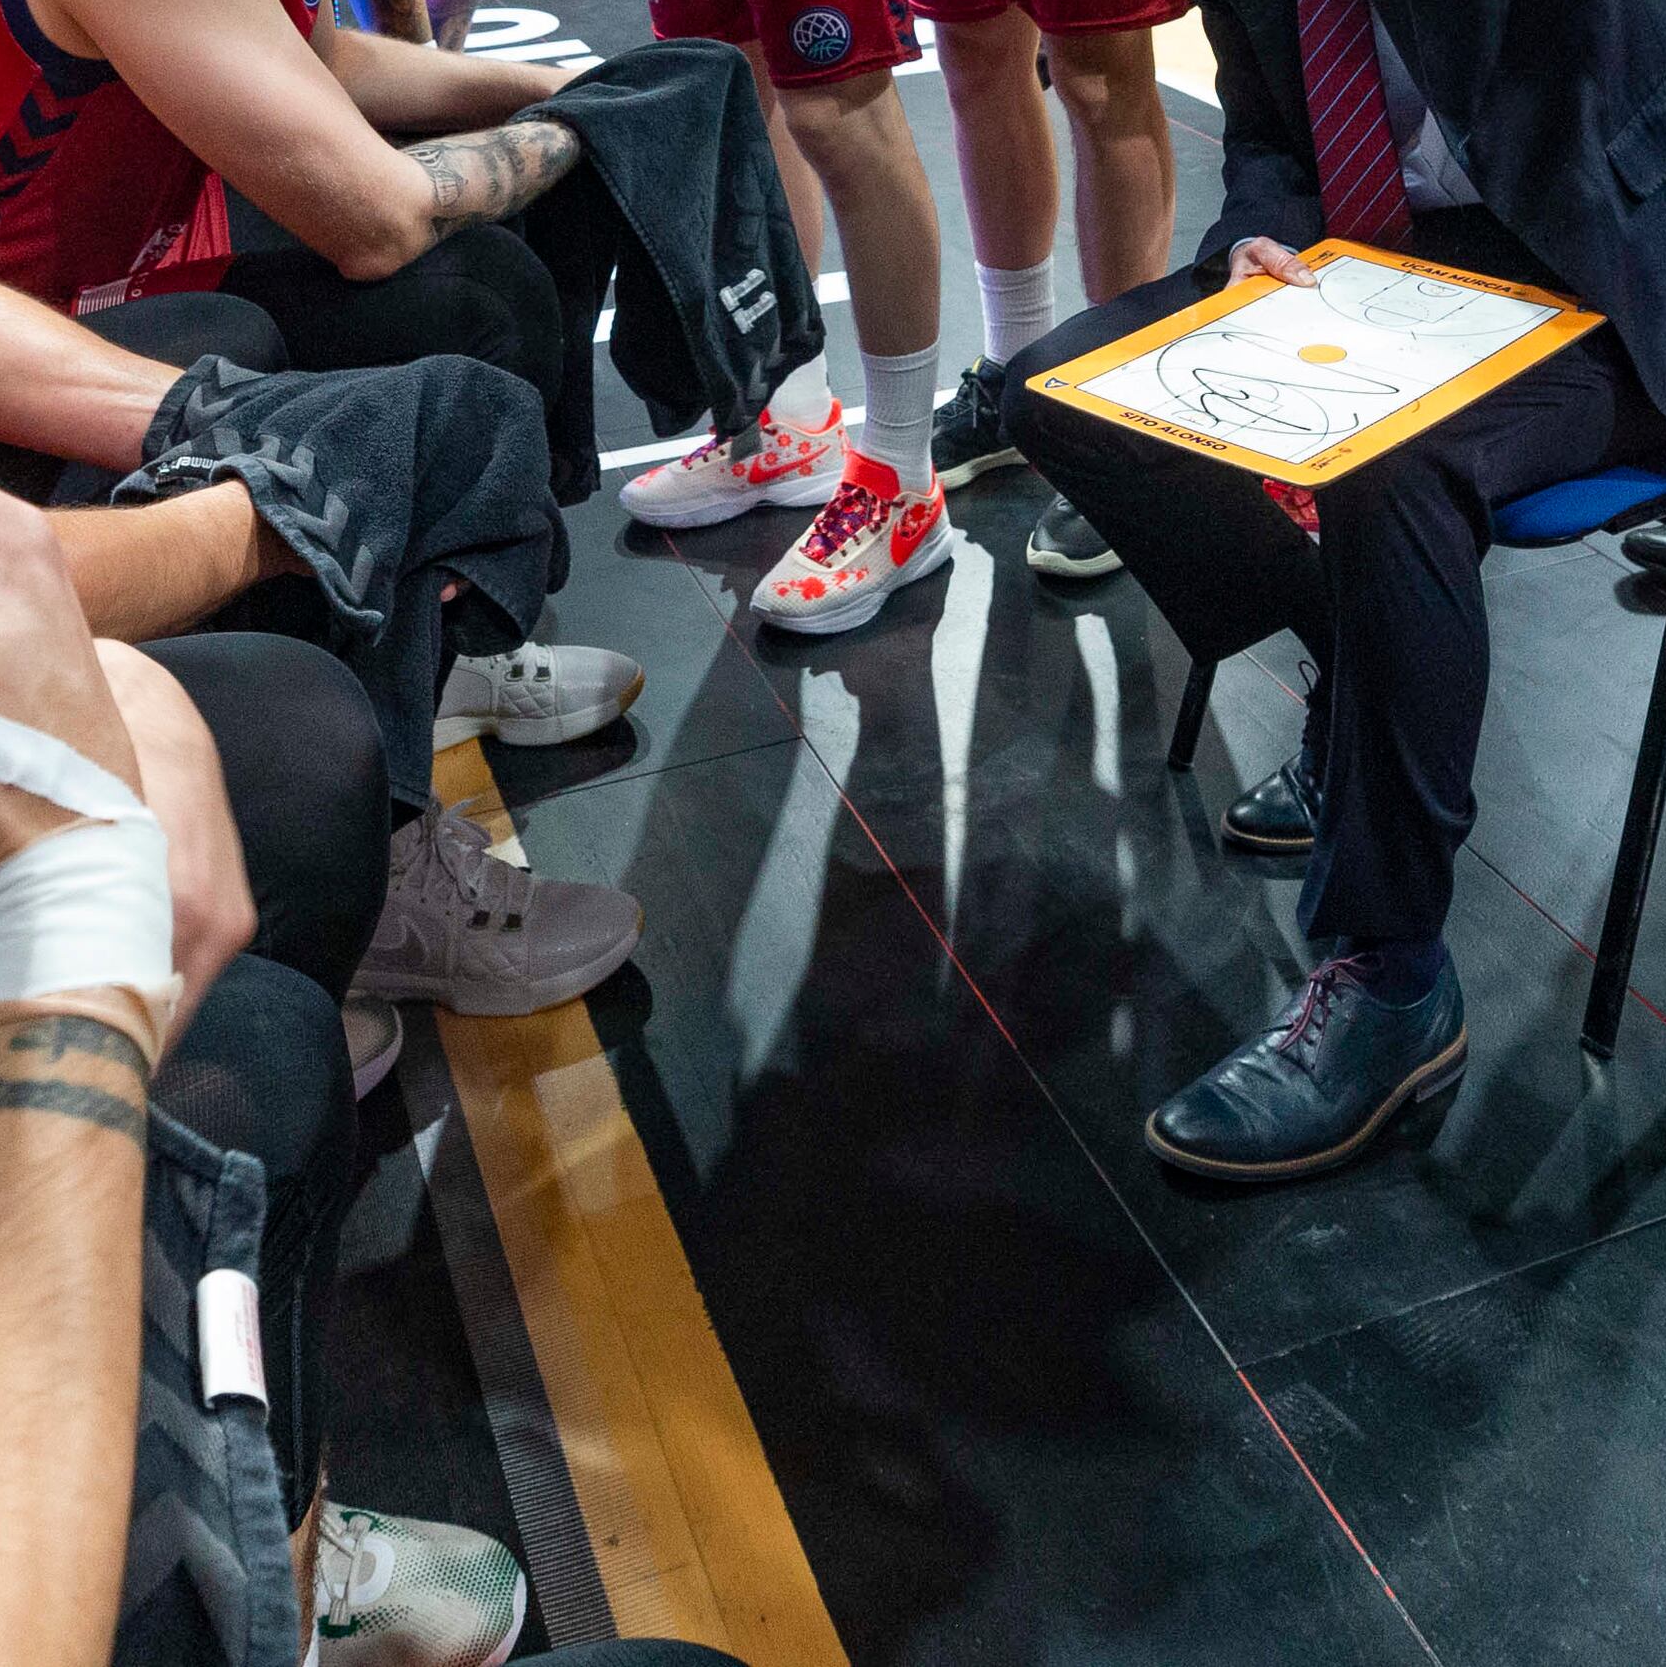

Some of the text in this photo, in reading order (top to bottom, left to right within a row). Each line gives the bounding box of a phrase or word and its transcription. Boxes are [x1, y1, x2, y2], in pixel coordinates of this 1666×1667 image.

[1401, 260, 1513, 294] UCAM MURCIA
[1120, 410, 1228, 451] SITO ALONSO
